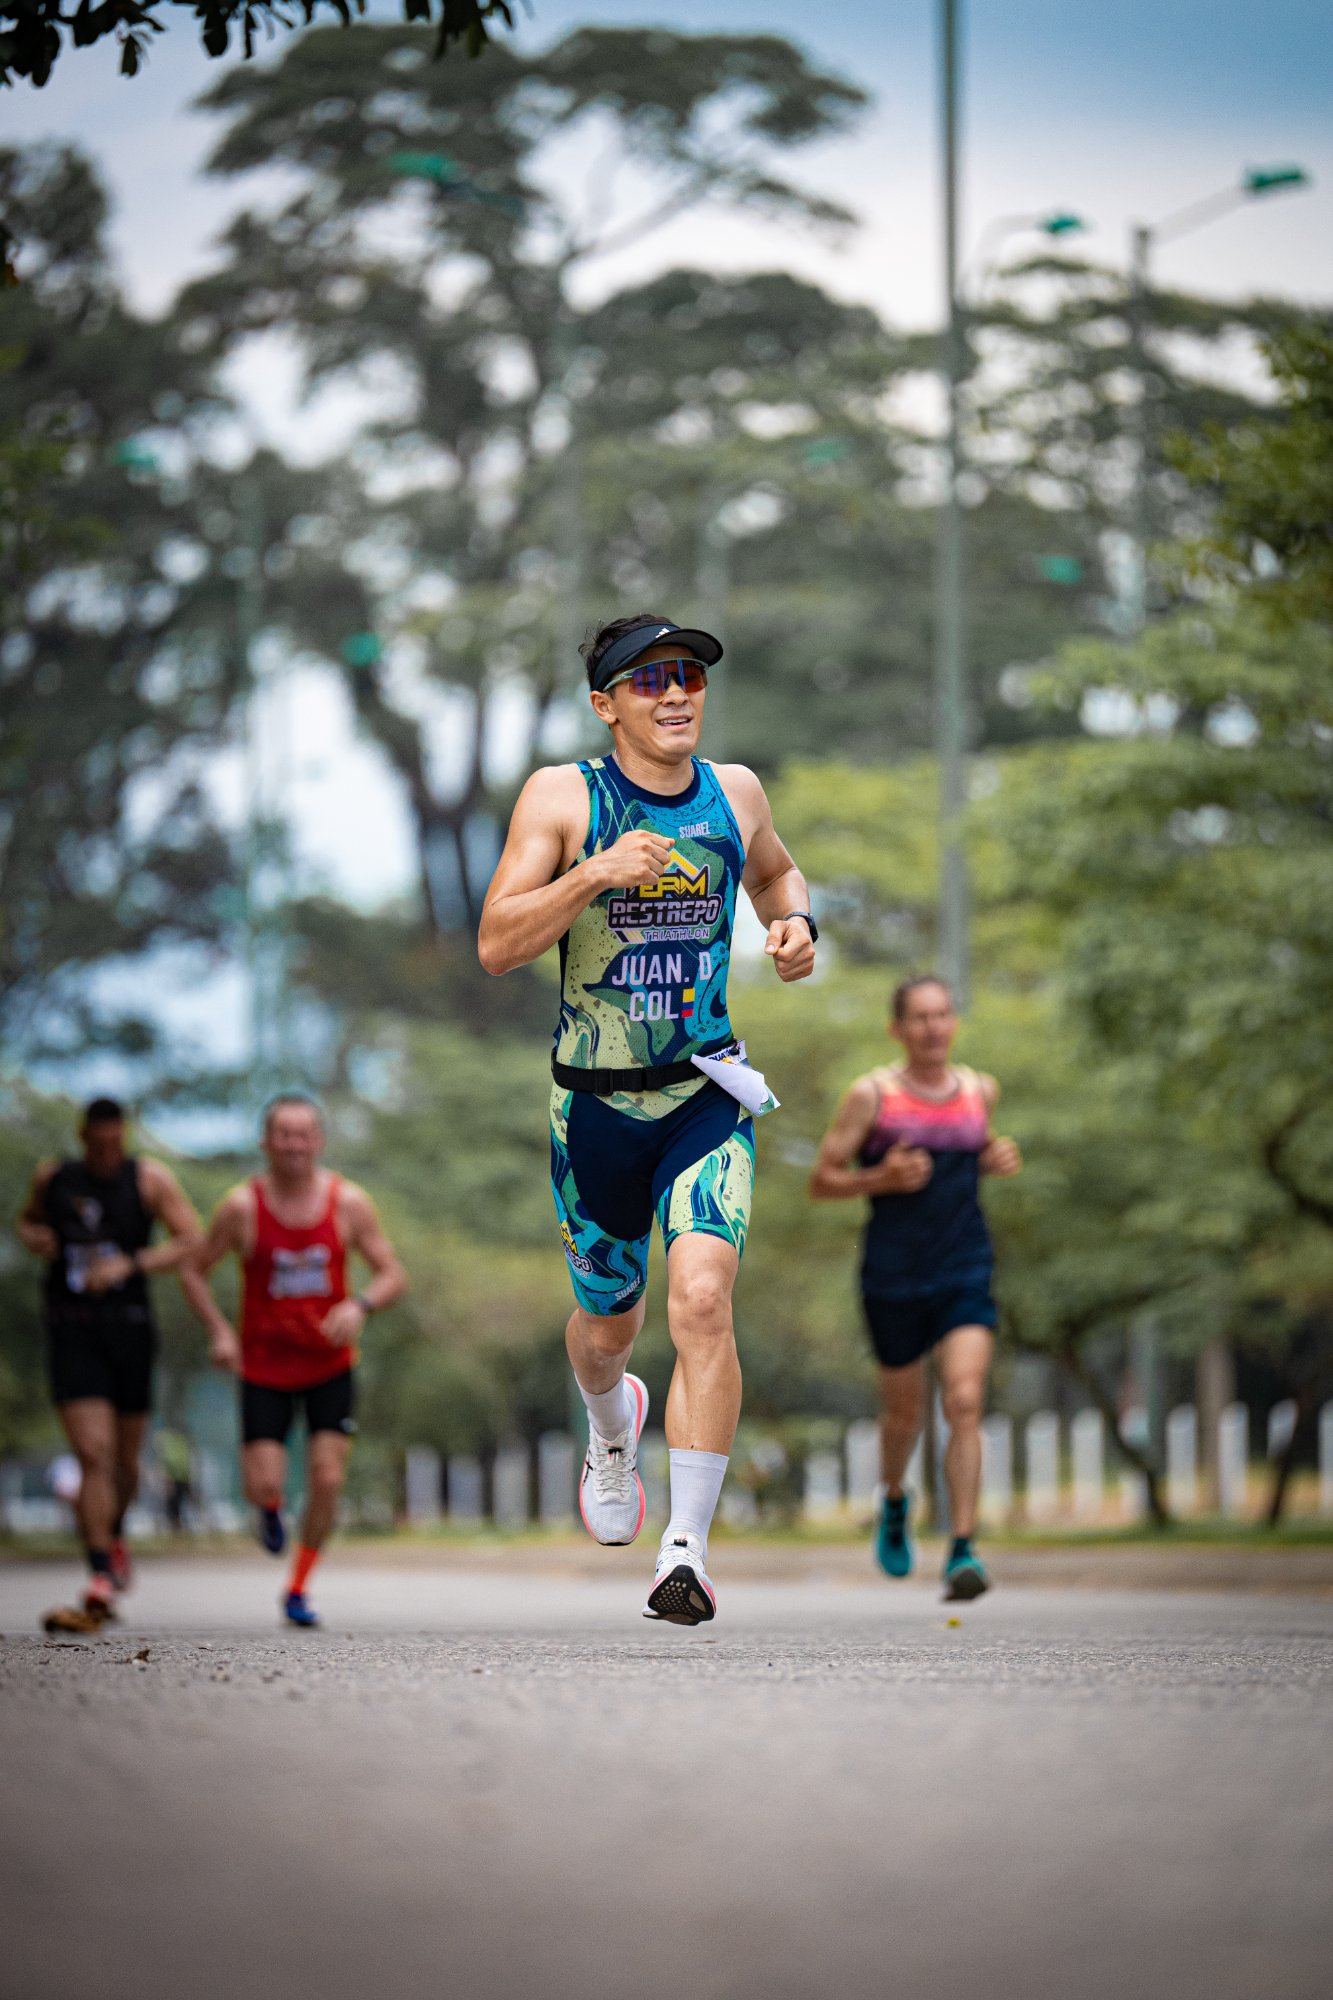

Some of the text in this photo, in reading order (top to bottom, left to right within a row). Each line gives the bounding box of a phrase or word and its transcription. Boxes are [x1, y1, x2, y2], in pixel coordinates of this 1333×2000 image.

[611, 899, 720, 925] RESTREPO
[645, 928, 709, 941] TRIATHLON
[612, 951, 713, 985] JUAN. D
[629, 990, 679, 1021] COL
